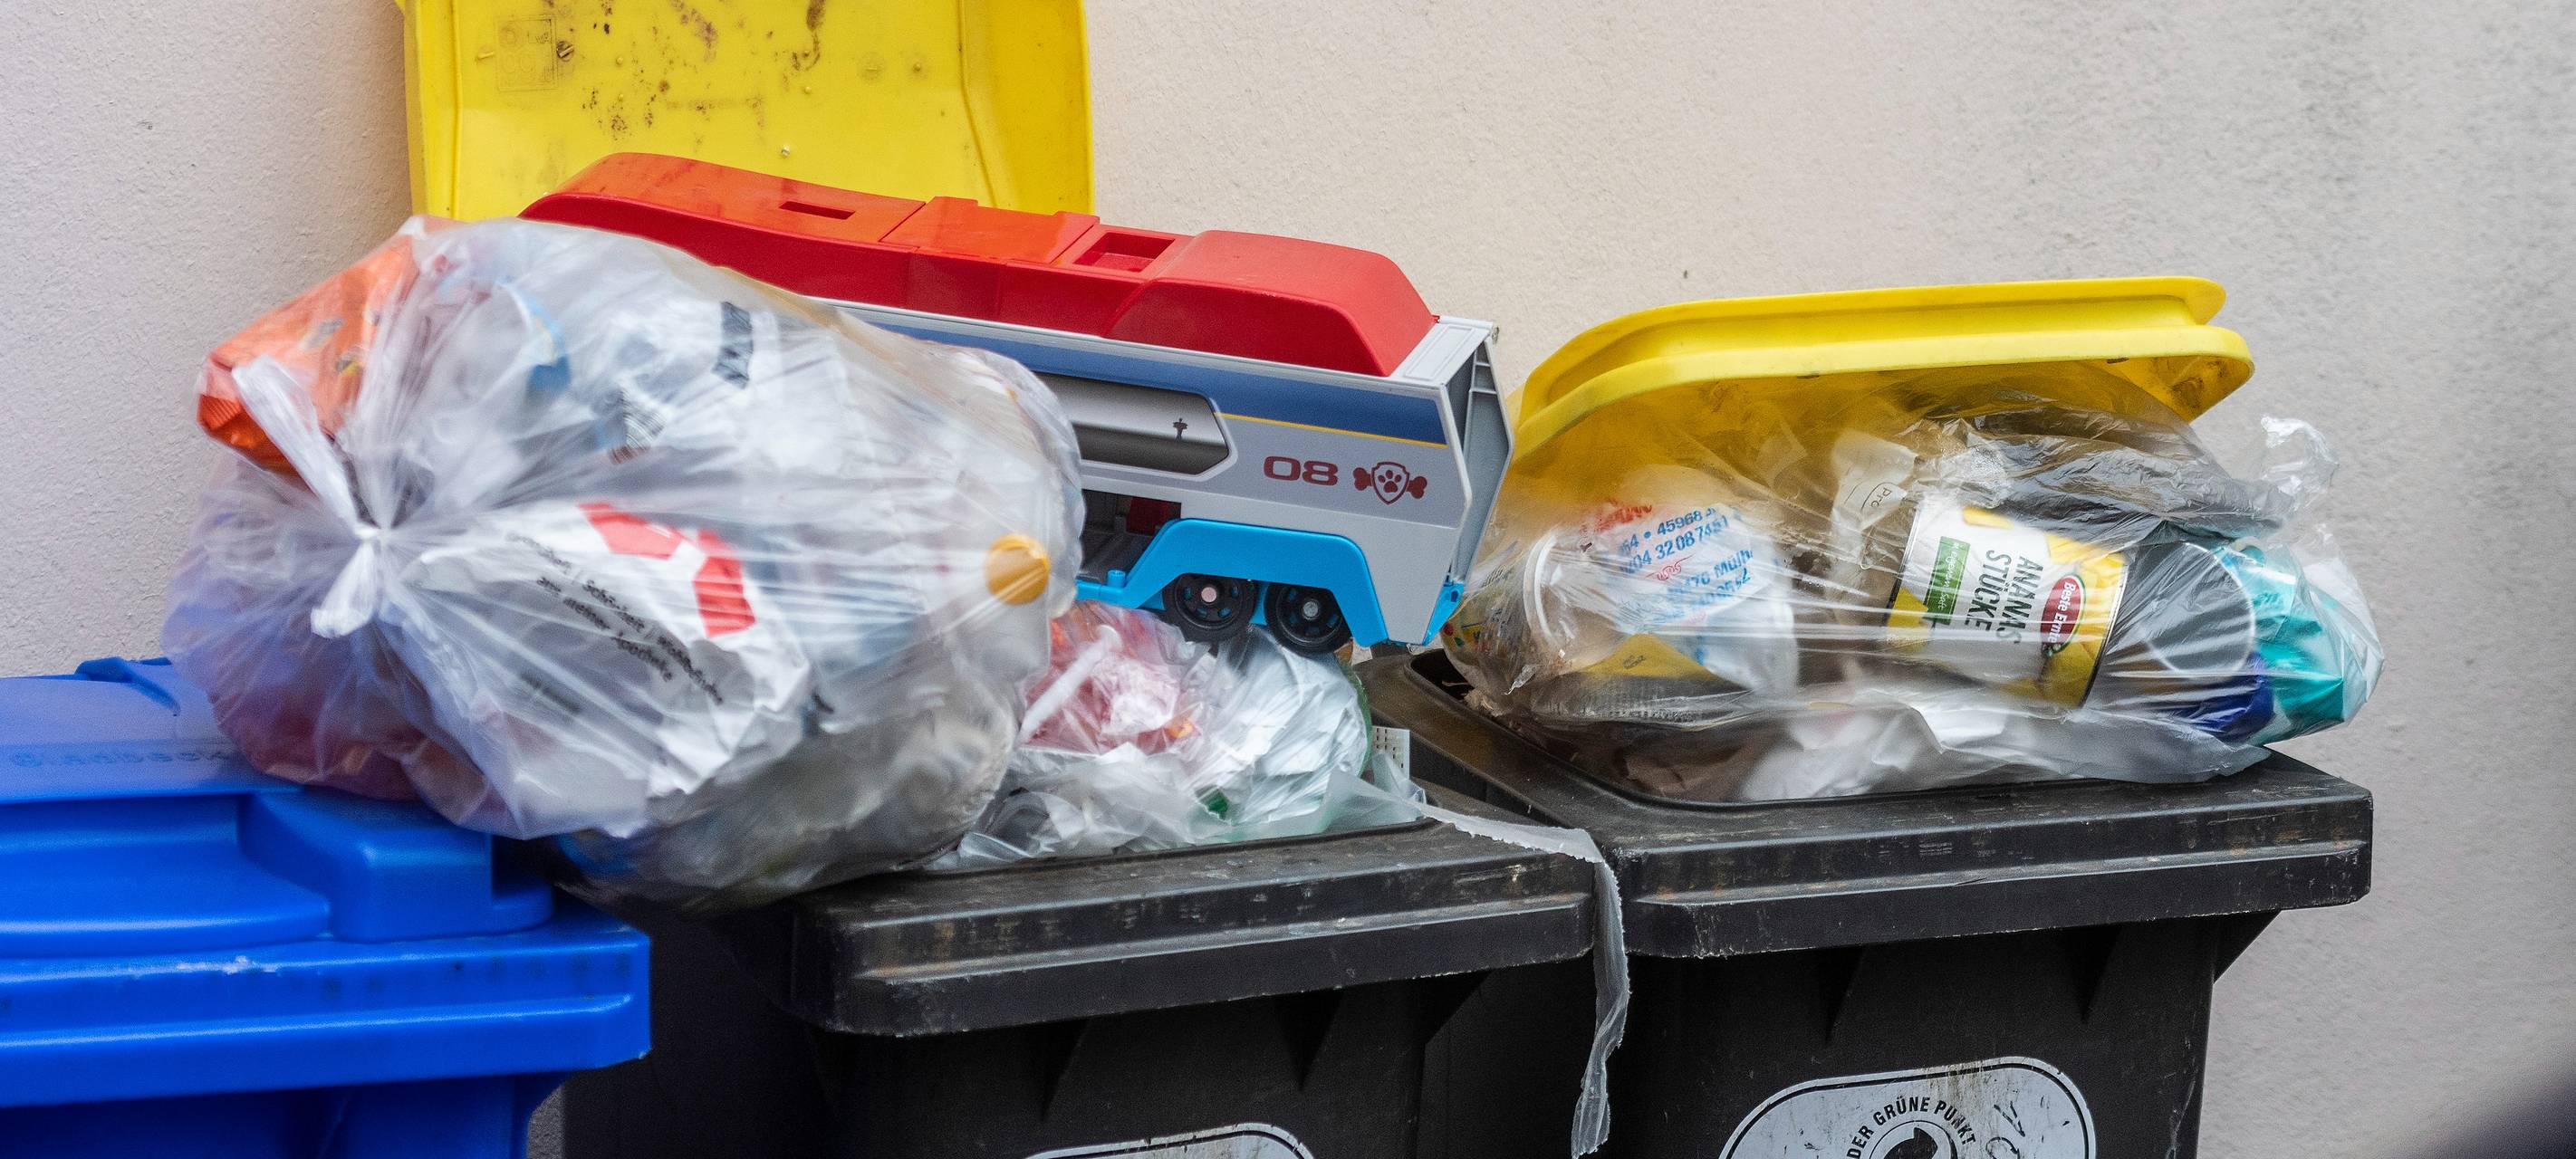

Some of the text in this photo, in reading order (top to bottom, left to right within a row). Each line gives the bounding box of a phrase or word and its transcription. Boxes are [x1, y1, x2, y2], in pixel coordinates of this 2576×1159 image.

[1264, 455, 1339, 486] 08
[1965, 549, 2012, 632] STÜCKE
[1995, 555, 2044, 644] ANANAS
[2048, 581, 2076, 644] Beste Ernte
[1846, 1125, 1874, 1159] DER
[1872, 1095, 1931, 1126] GRÜNE
[1933, 1099, 1976, 1145] PUNKT
